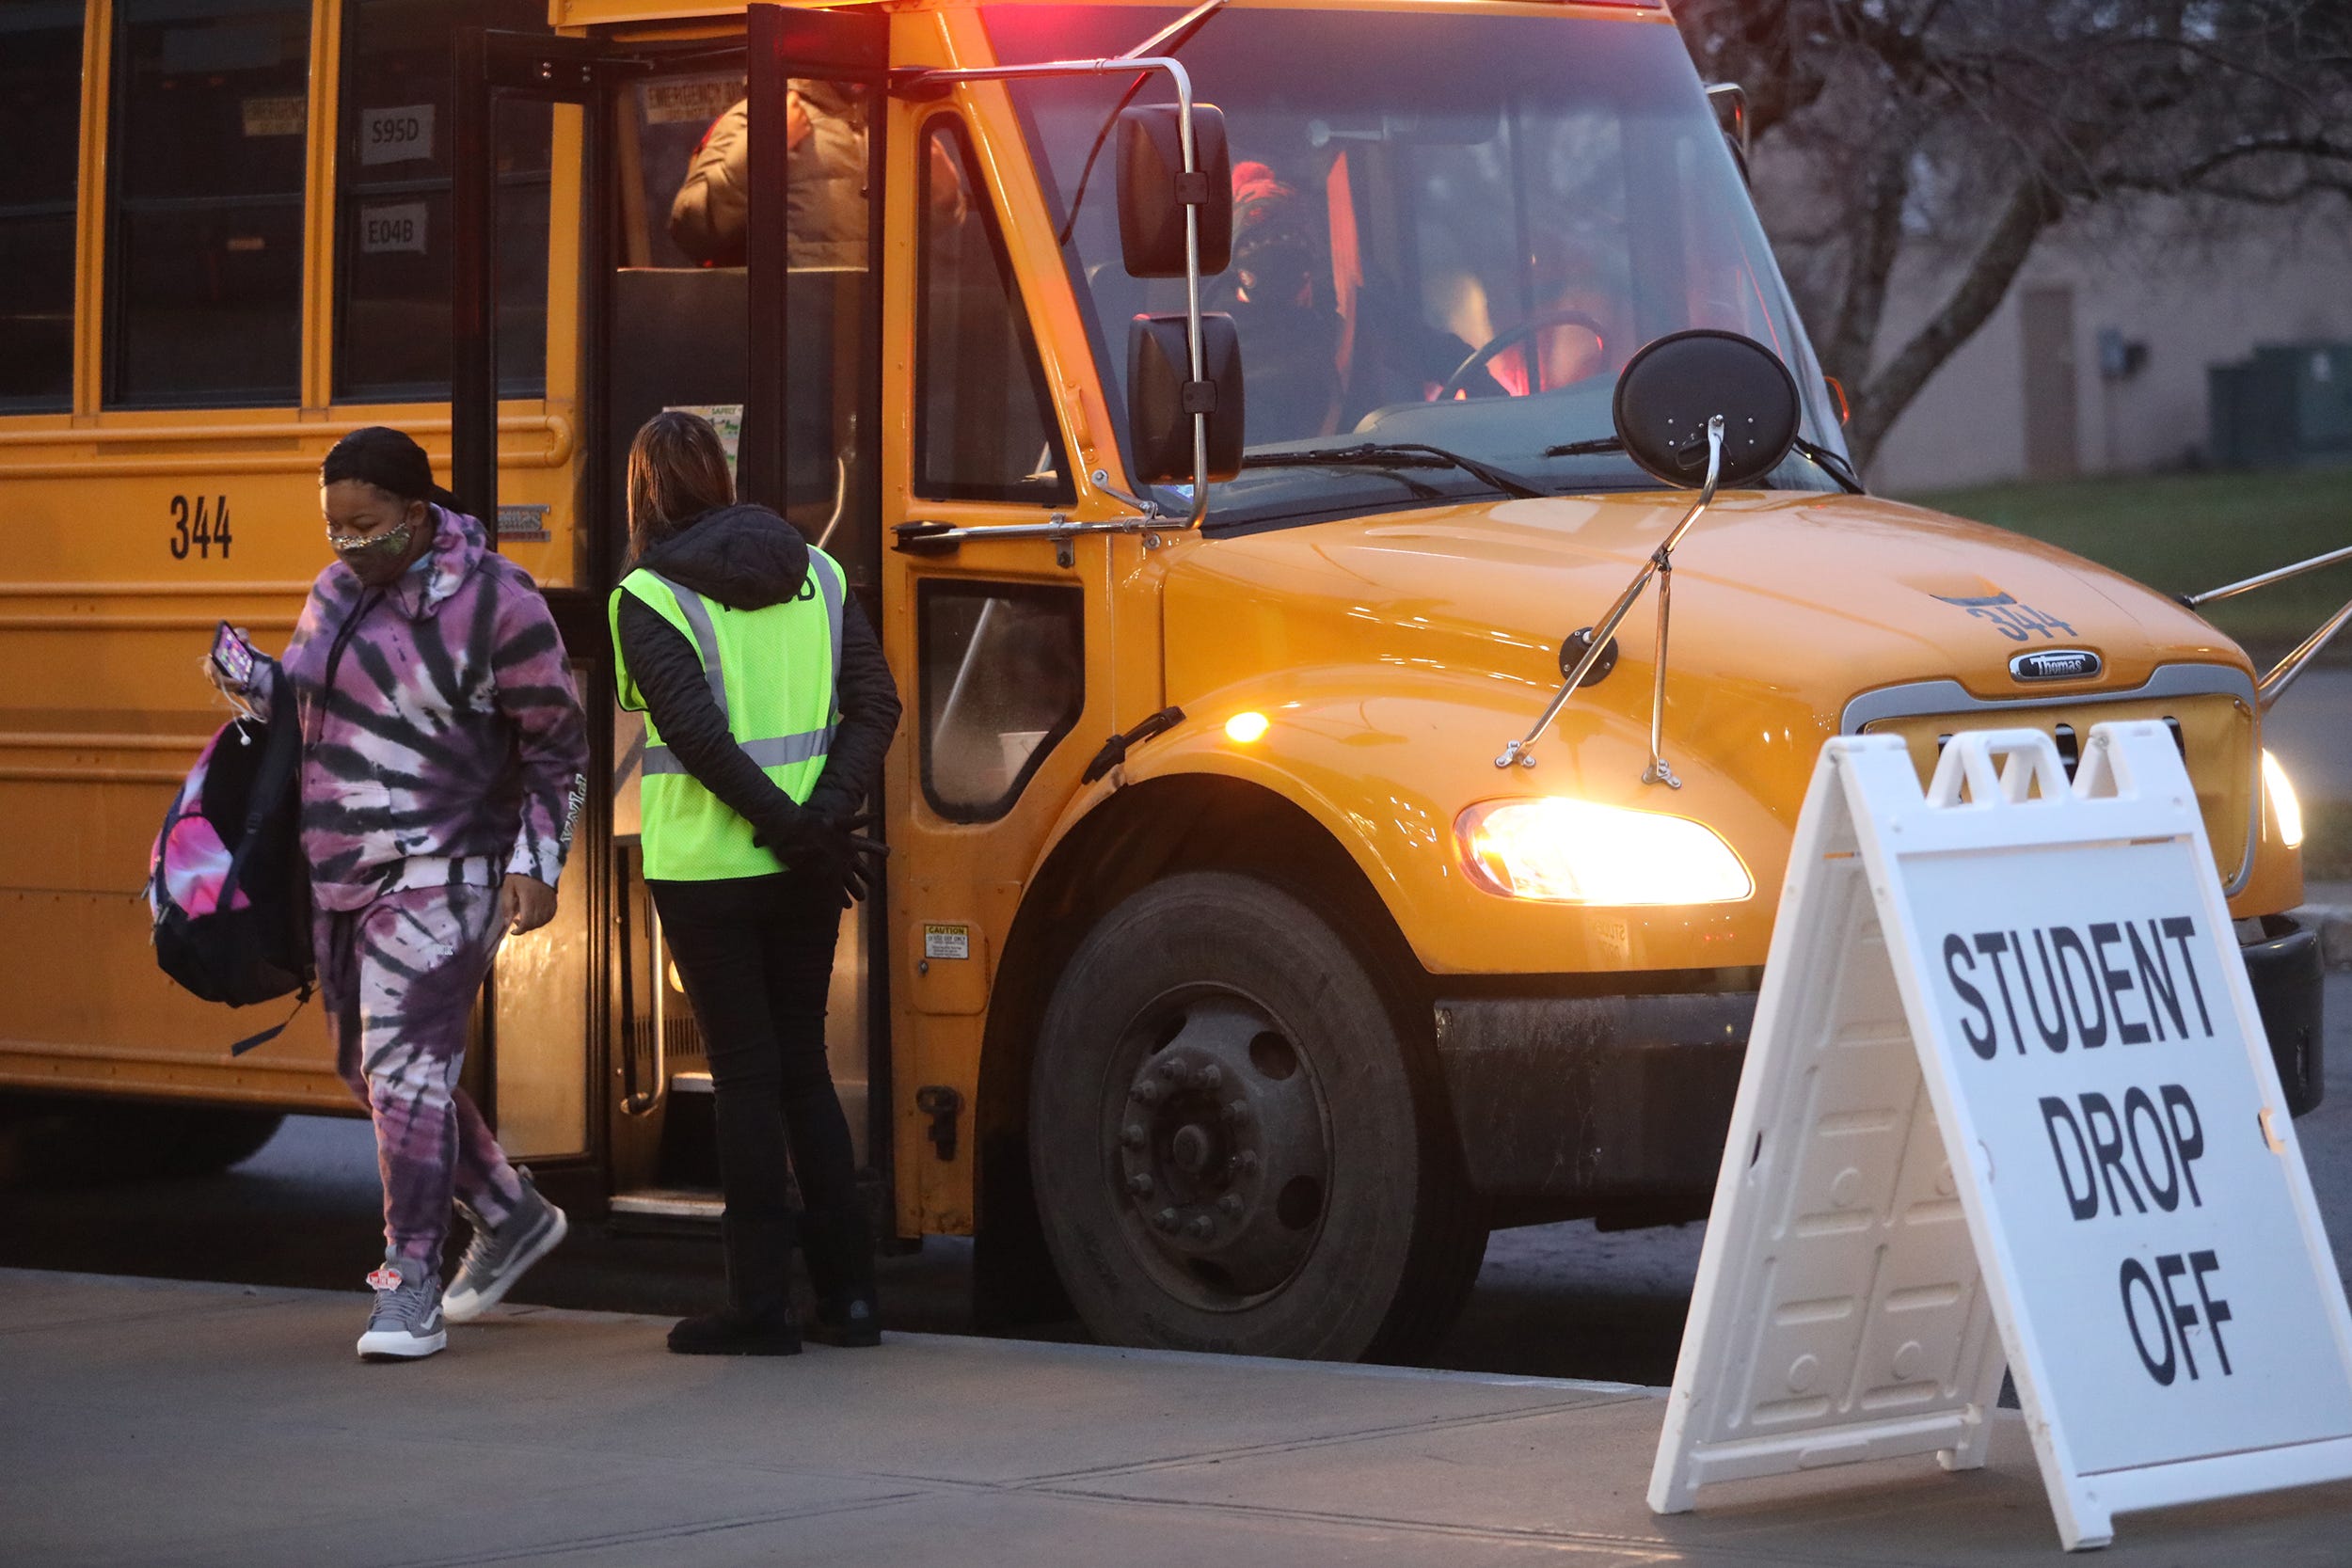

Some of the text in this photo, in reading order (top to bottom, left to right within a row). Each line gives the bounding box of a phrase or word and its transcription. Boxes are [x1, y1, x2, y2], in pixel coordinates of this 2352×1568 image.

[371, 117, 420, 144] S95D
[367, 218, 414, 244] E04B
[169, 495, 233, 559] 344
[1966, 604, 2078, 641] 344
[2029, 655, 2087, 676] Thomas
[1943, 915, 2214, 1061] STUDENT
[2038, 1084, 2204, 1221] DROP
[2119, 1249, 2233, 1386] OFF
